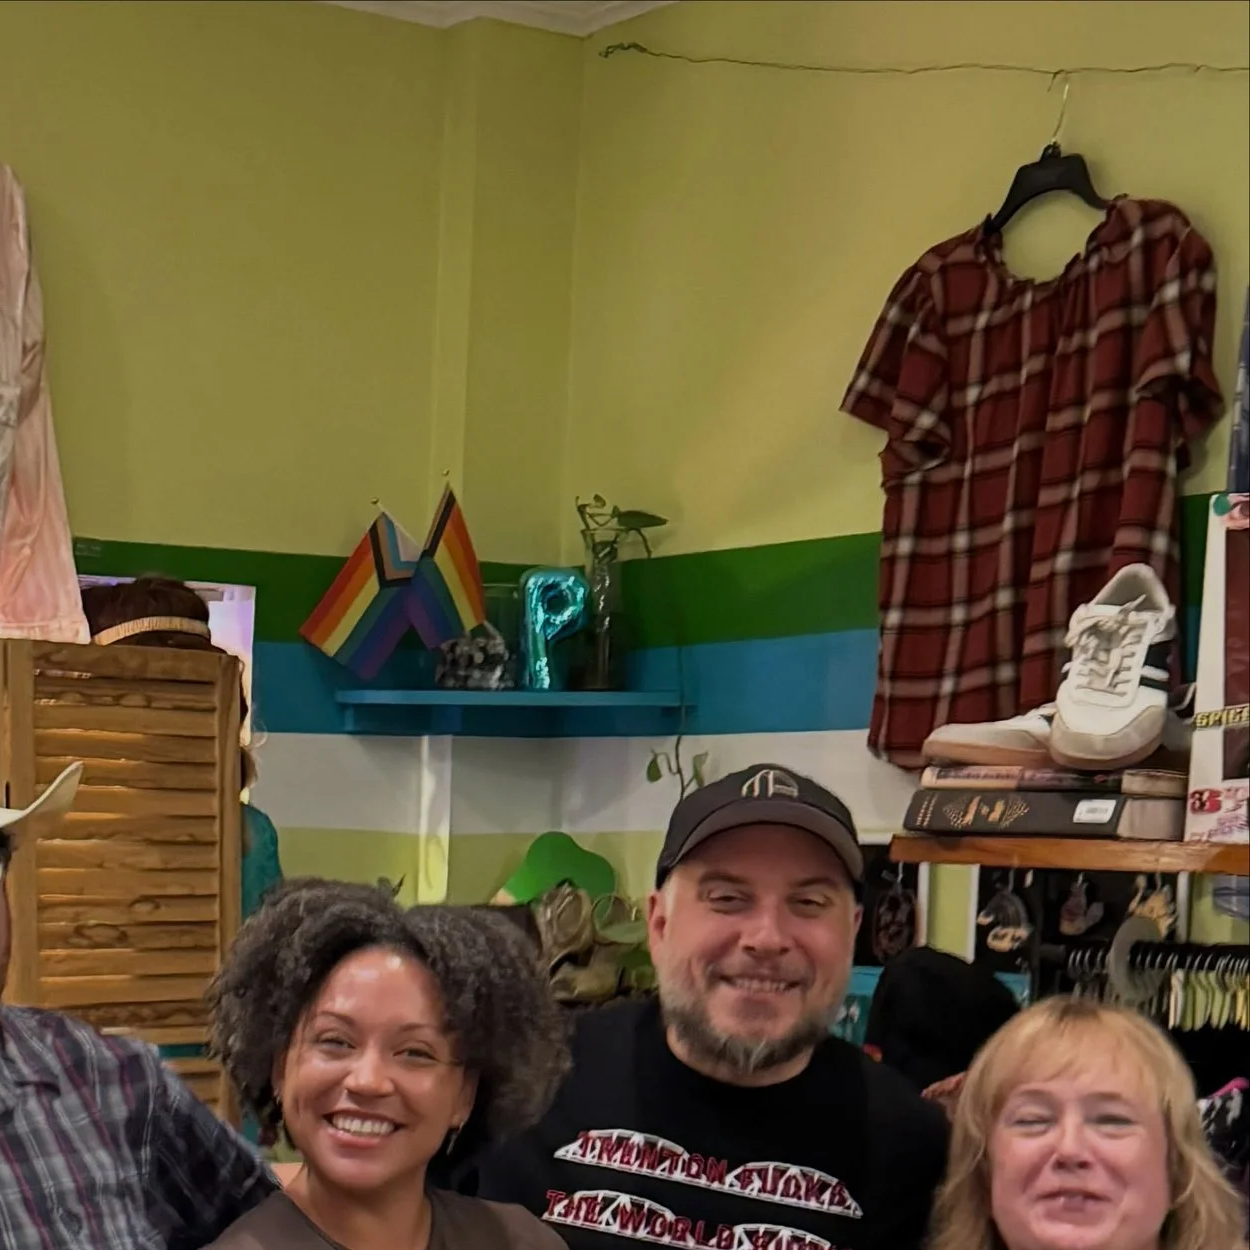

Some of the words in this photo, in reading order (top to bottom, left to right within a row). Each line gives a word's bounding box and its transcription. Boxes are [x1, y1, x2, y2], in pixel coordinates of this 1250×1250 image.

[519, 567, 589, 690] P
[576, 1130, 728, 1187] TRENTON
[545, 1189, 603, 1225] THE
[617, 1203, 737, 1250] WORLD
